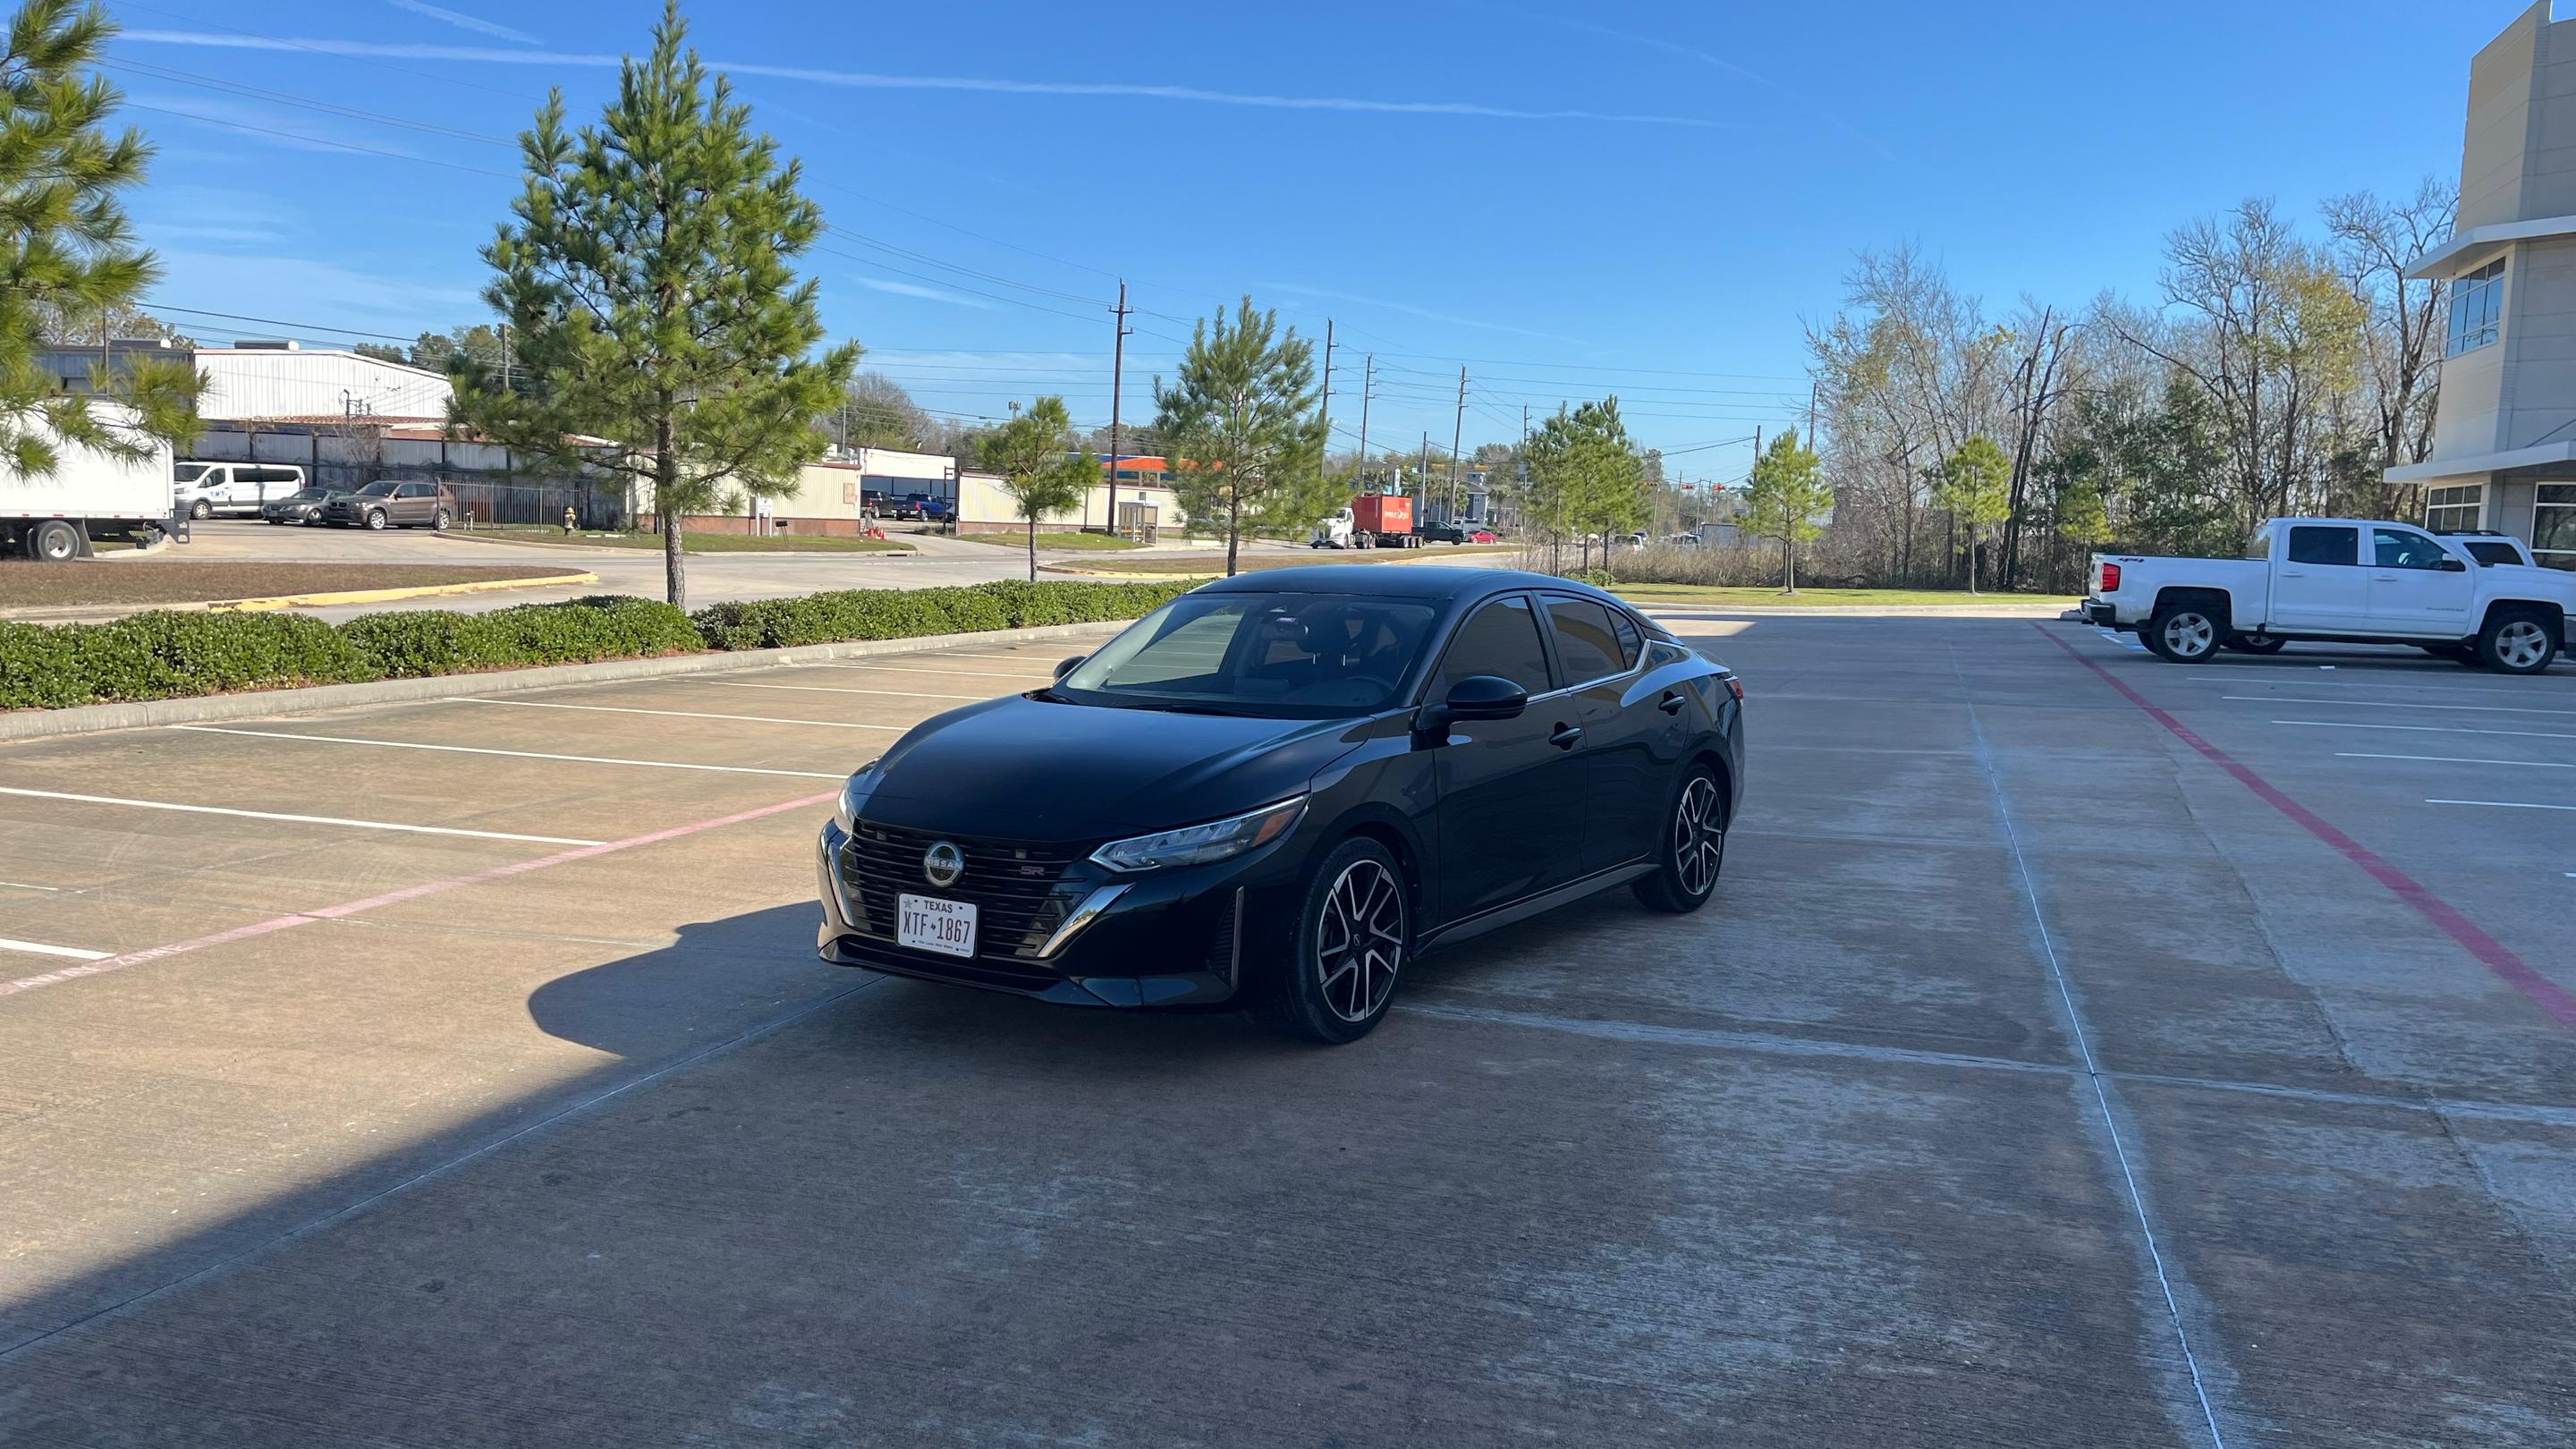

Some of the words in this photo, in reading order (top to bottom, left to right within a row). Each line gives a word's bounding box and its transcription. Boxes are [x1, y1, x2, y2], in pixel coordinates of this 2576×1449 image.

[926, 857, 963, 870] NISSAN
[1021, 866, 1045, 876] SR
[924, 900, 953, 913] TEXAS
[903, 911, 928, 936] XTF
[936, 917, 970, 945] 1867
